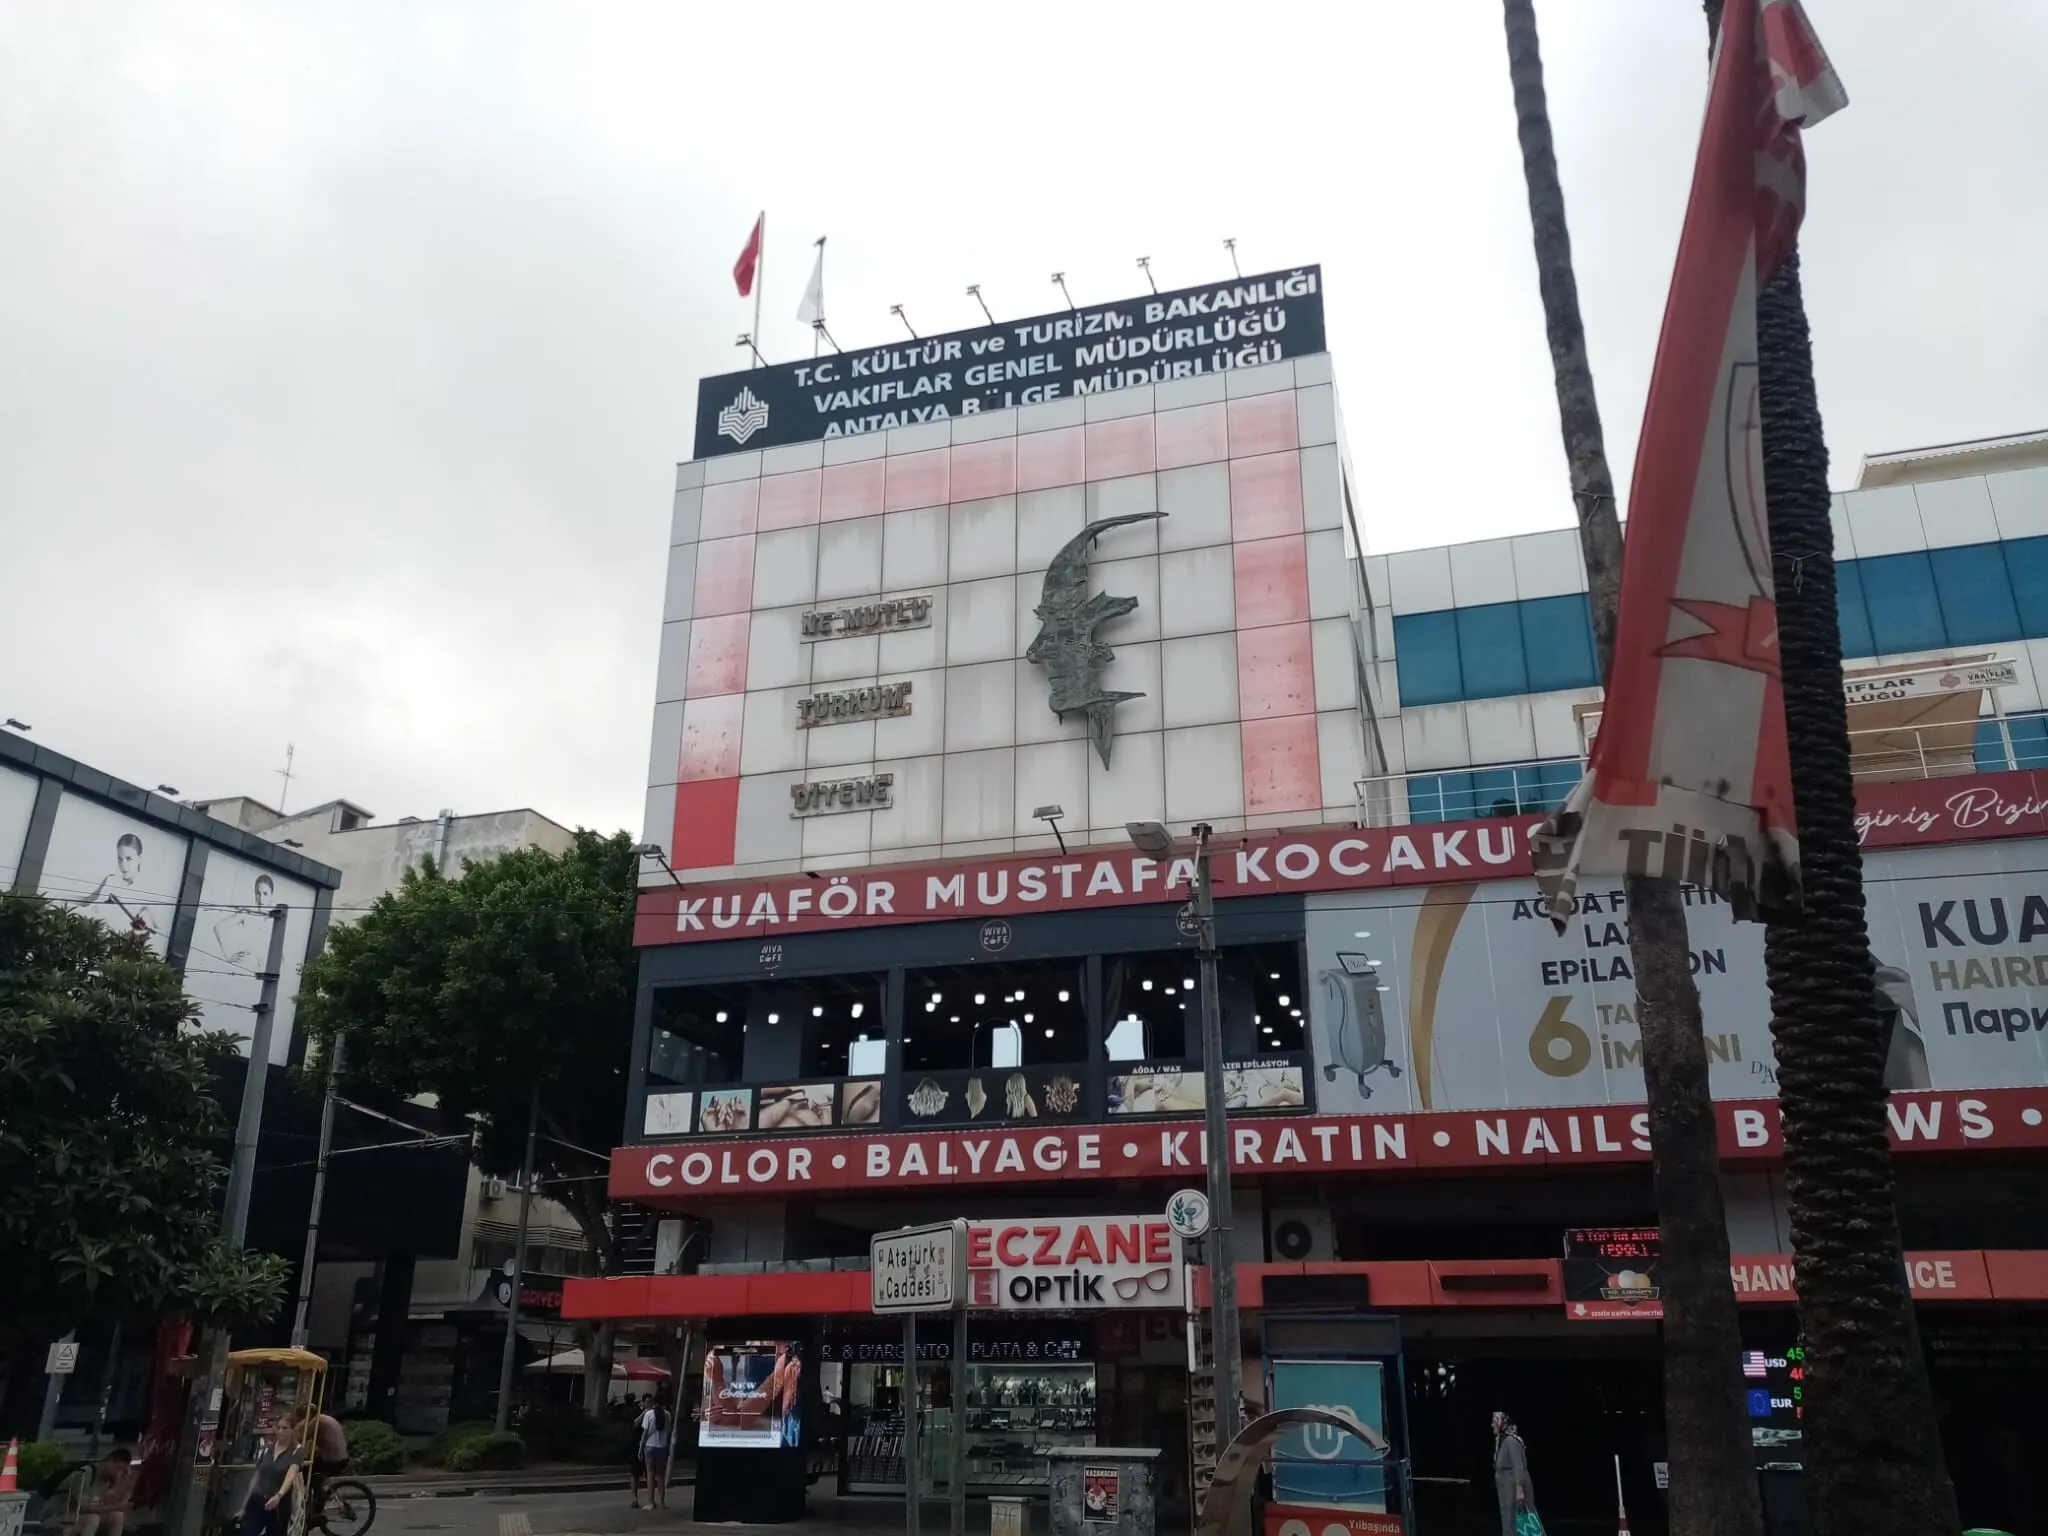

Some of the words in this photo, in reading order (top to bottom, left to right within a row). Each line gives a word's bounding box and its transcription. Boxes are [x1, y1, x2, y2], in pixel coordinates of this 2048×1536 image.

[794, 363, 841, 388] T.C.
[851, 339, 962, 378] KÜLTÜR
[970, 336, 1005, 355] ve
[1145, 270, 1318, 324] BAKANLIĞI
[814, 373, 953, 414] VAKIFLAR
[964, 352, 1063, 387] GENEL
[1075, 306, 1286, 367] MÜDÜRLÜĞÜ
[1073, 339, 1282, 397] MÜDÜRLÜĞÜ
[801, 612, 832, 637] NE
[842, 598, 929, 630] MUTLU
[675, 876, 896, 932] KUAFÖR
[926, 858, 1199, 910] MUSTAFA
[1528, 995, 1592, 1078] 6
[1163, 1065, 1181, 1073] WAX
[1243, 1058, 1290, 1069] EPİLASYON
[646, 1147, 812, 1188] COLOR
[866, 1134, 1100, 1177] BALYAGE
[1475, 1112, 1652, 1157] NAILS
[887, 1240, 936, 1268] Atatürk
[967, 1222, 1172, 1267] ECZANE
[886, 1275, 936, 1299] Caddesi
[1009, 1268, 1104, 1302] OPTİK
[971, 1341, 1022, 1358] PLATA
[1764, 1358, 1787, 1369] USD
[1770, 1397, 1793, 1408] EUR
[1348, 1518, 1400, 1534] Yılbaşında
